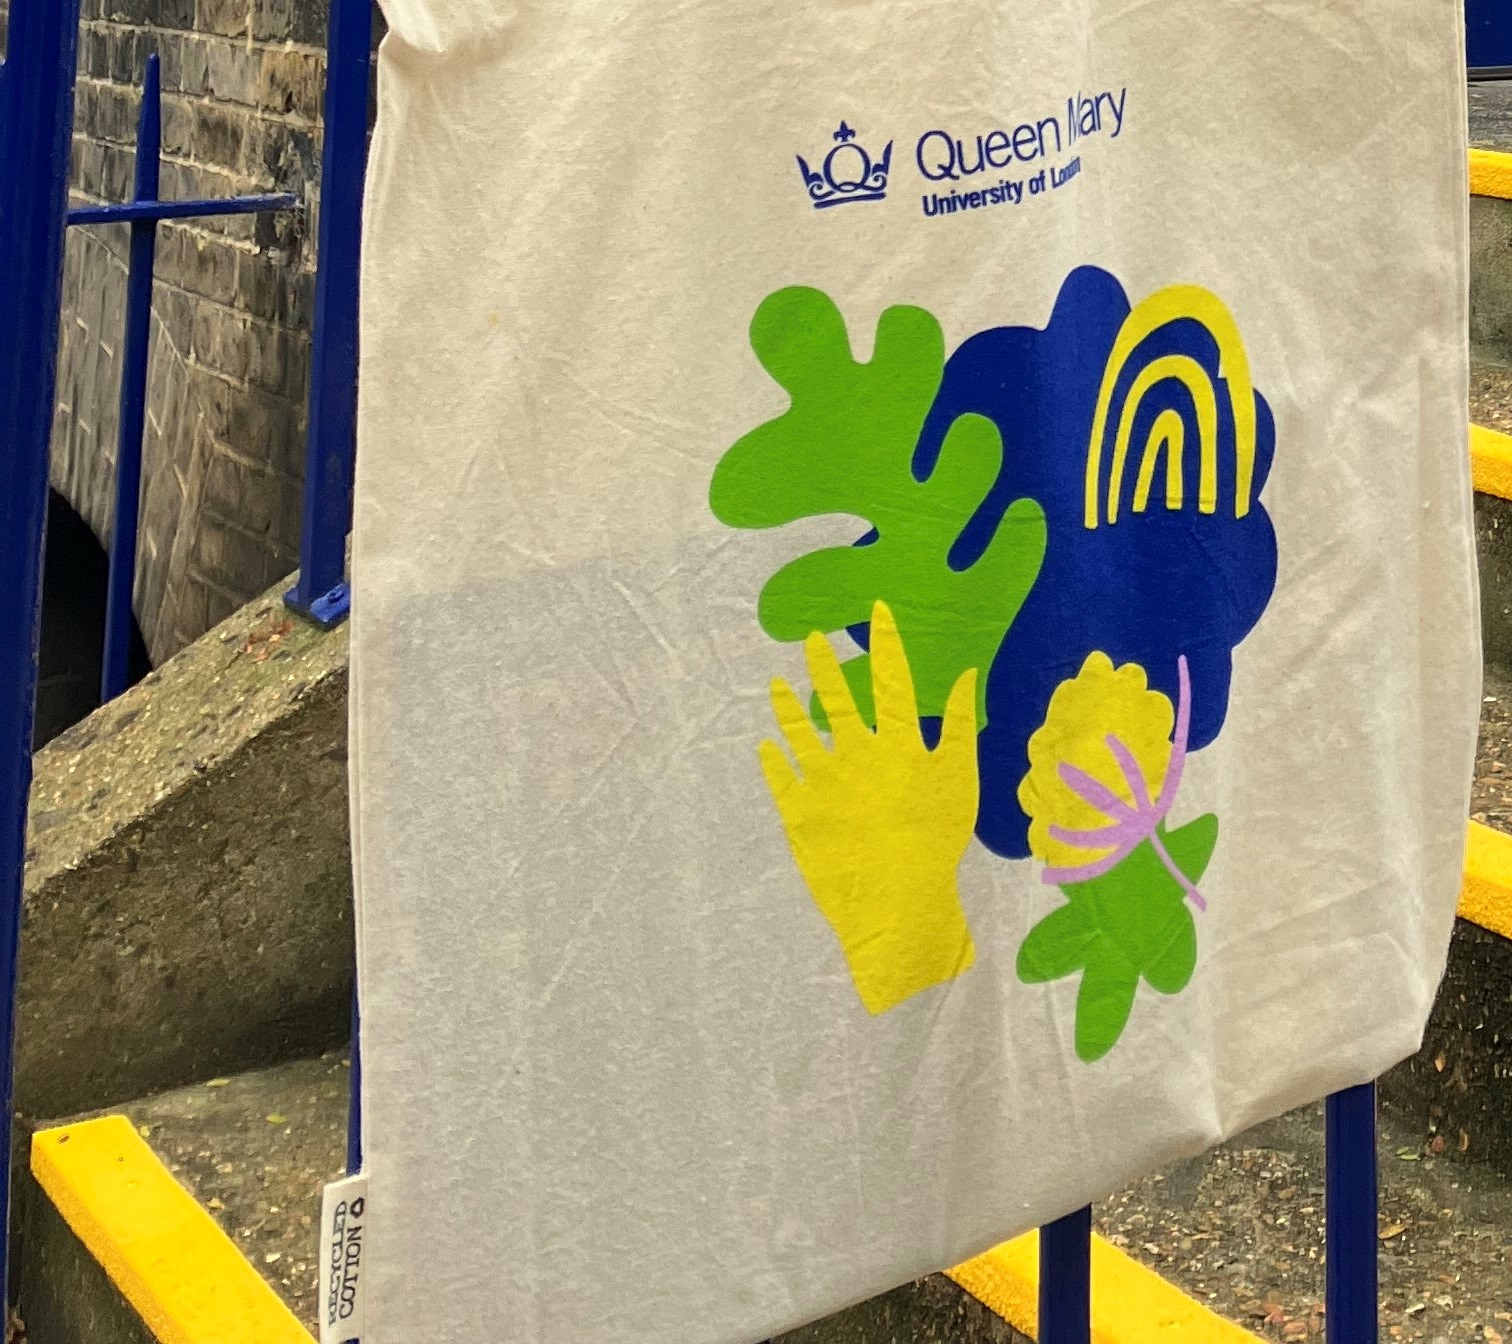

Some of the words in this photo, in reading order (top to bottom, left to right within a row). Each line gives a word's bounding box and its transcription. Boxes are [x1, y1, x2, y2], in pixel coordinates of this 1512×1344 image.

[917, 117, 1061, 180] Queen
[922, 179, 1023, 217] University
[1029, 169, 1046, 195] of
[328, 1201, 348, 1326] RECYCLED
[339, 1225, 363, 1319] COTTON
